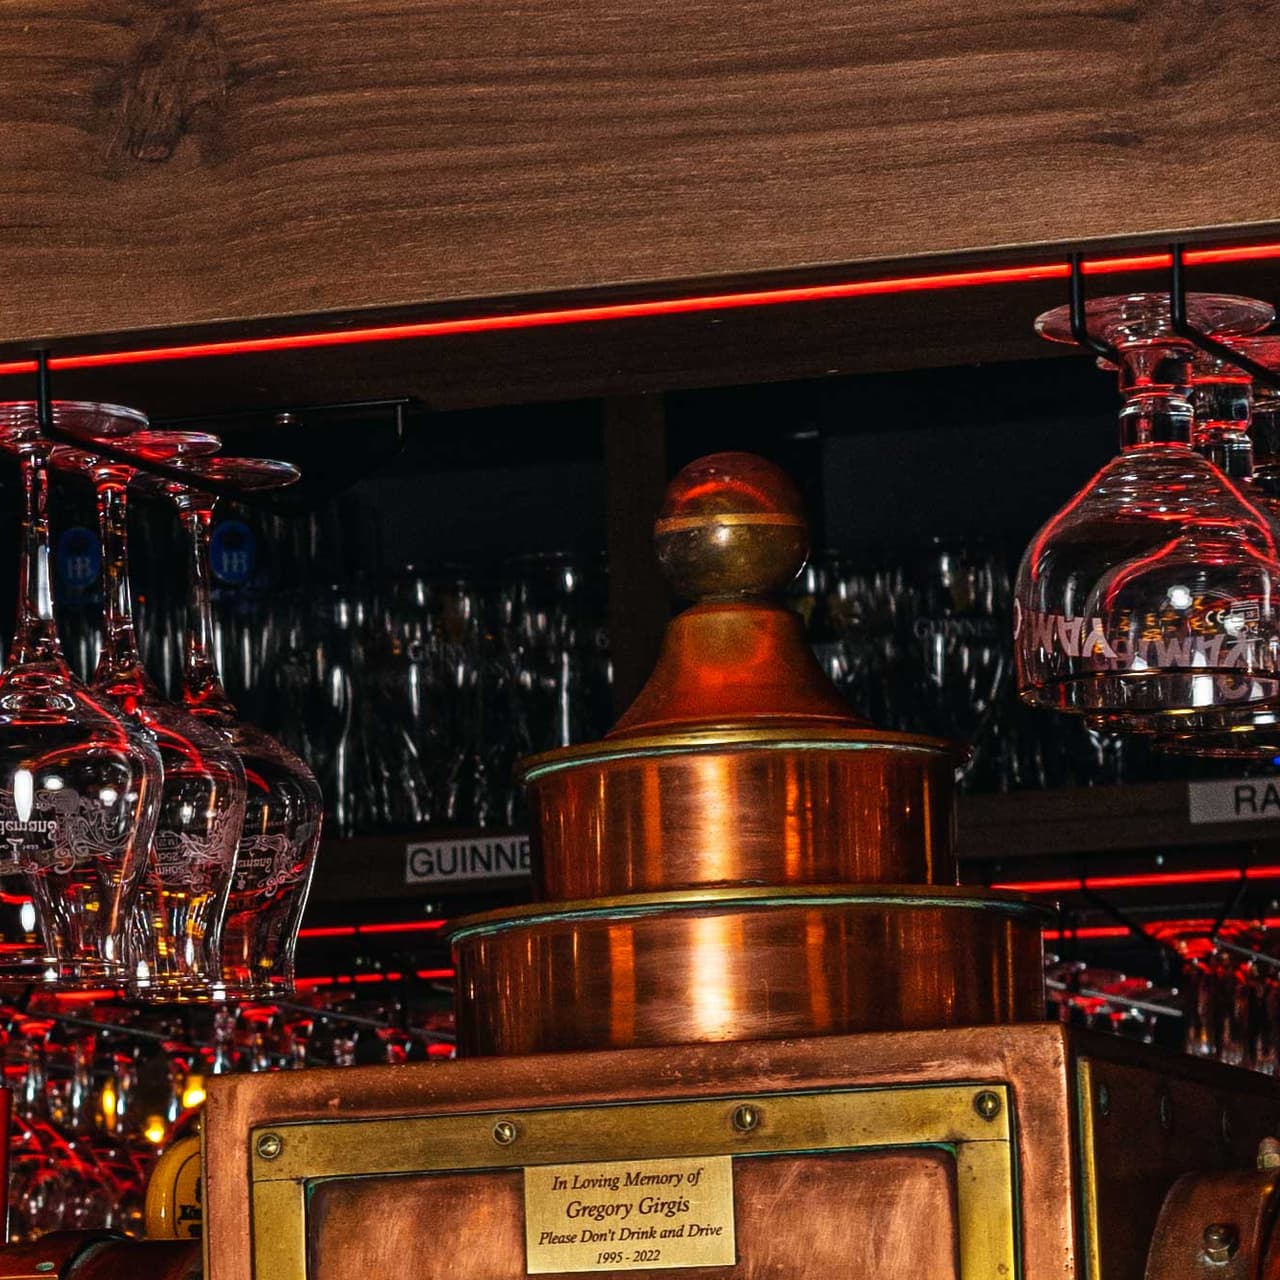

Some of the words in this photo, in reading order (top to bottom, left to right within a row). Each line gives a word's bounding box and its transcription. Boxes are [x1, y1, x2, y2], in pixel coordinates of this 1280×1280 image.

[552, 1176, 567, 1190] In
[571, 1174, 620, 1191] Loving
[624, 1172, 683, 1188] Memory
[687, 1167, 704, 1186] of
[566, 1200, 633, 1221] Gregory
[639, 1195, 690, 1217] Girgis
[538, 1231, 577, 1245] Please
[580, 1228, 615, 1243] Don't
[619, 1226, 657, 1241] Drink
[660, 1225, 684, 1239] and
[687, 1223, 723, 1238] Drive
[597, 1251, 623, 1264] 1995
[633, 1249, 661, 1262] 2022
